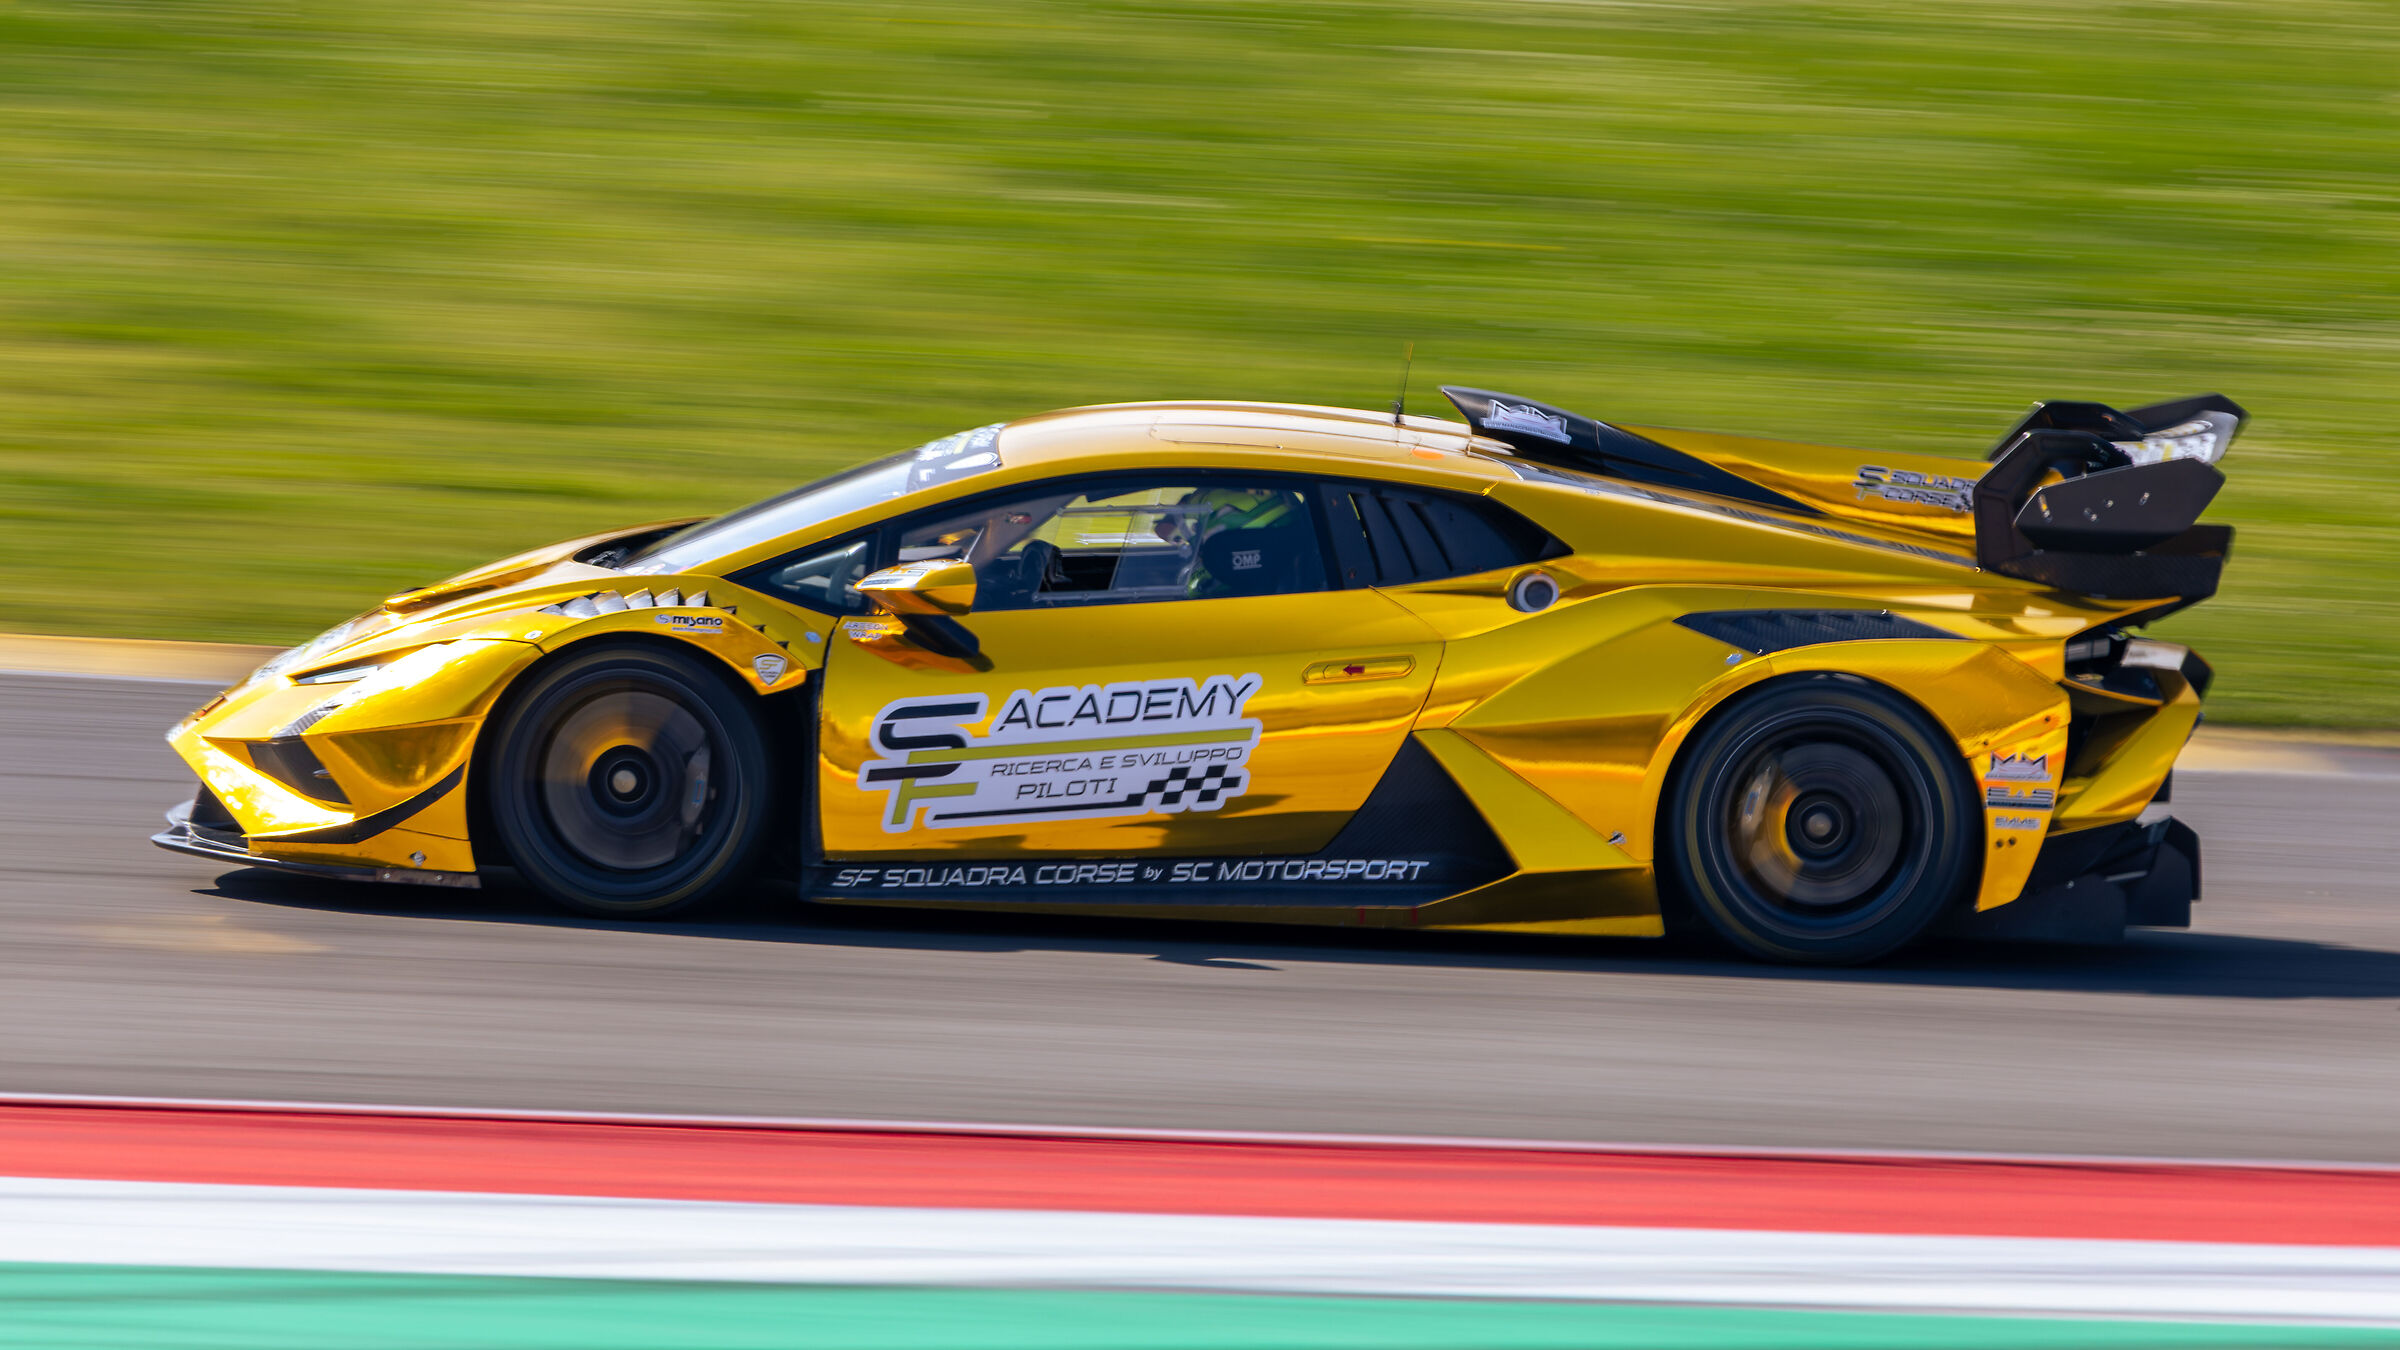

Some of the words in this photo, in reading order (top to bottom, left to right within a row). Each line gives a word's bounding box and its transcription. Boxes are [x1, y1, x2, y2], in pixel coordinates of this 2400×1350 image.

[1884, 486, 1958, 506] CORSE
[1232, 553, 1261, 567] OMP
[672, 615, 723, 626] misano
[998, 681, 1253, 732] ACADEMY
[990, 757, 1092, 777] RICERCA
[1099, 754, 1117, 770] E
[1121, 747, 1243, 766] SVILUPPO
[1016, 777, 1117, 800] PILOTI
[832, 869, 880, 887] SF
[881, 866, 1027, 887] SQUADRA
[1034, 863, 1138, 885] CORSE
[1143, 866, 1163, 881] by
[1169, 862, 1213, 882] SC
[1215, 859, 1430, 881] MOTORSPORT
